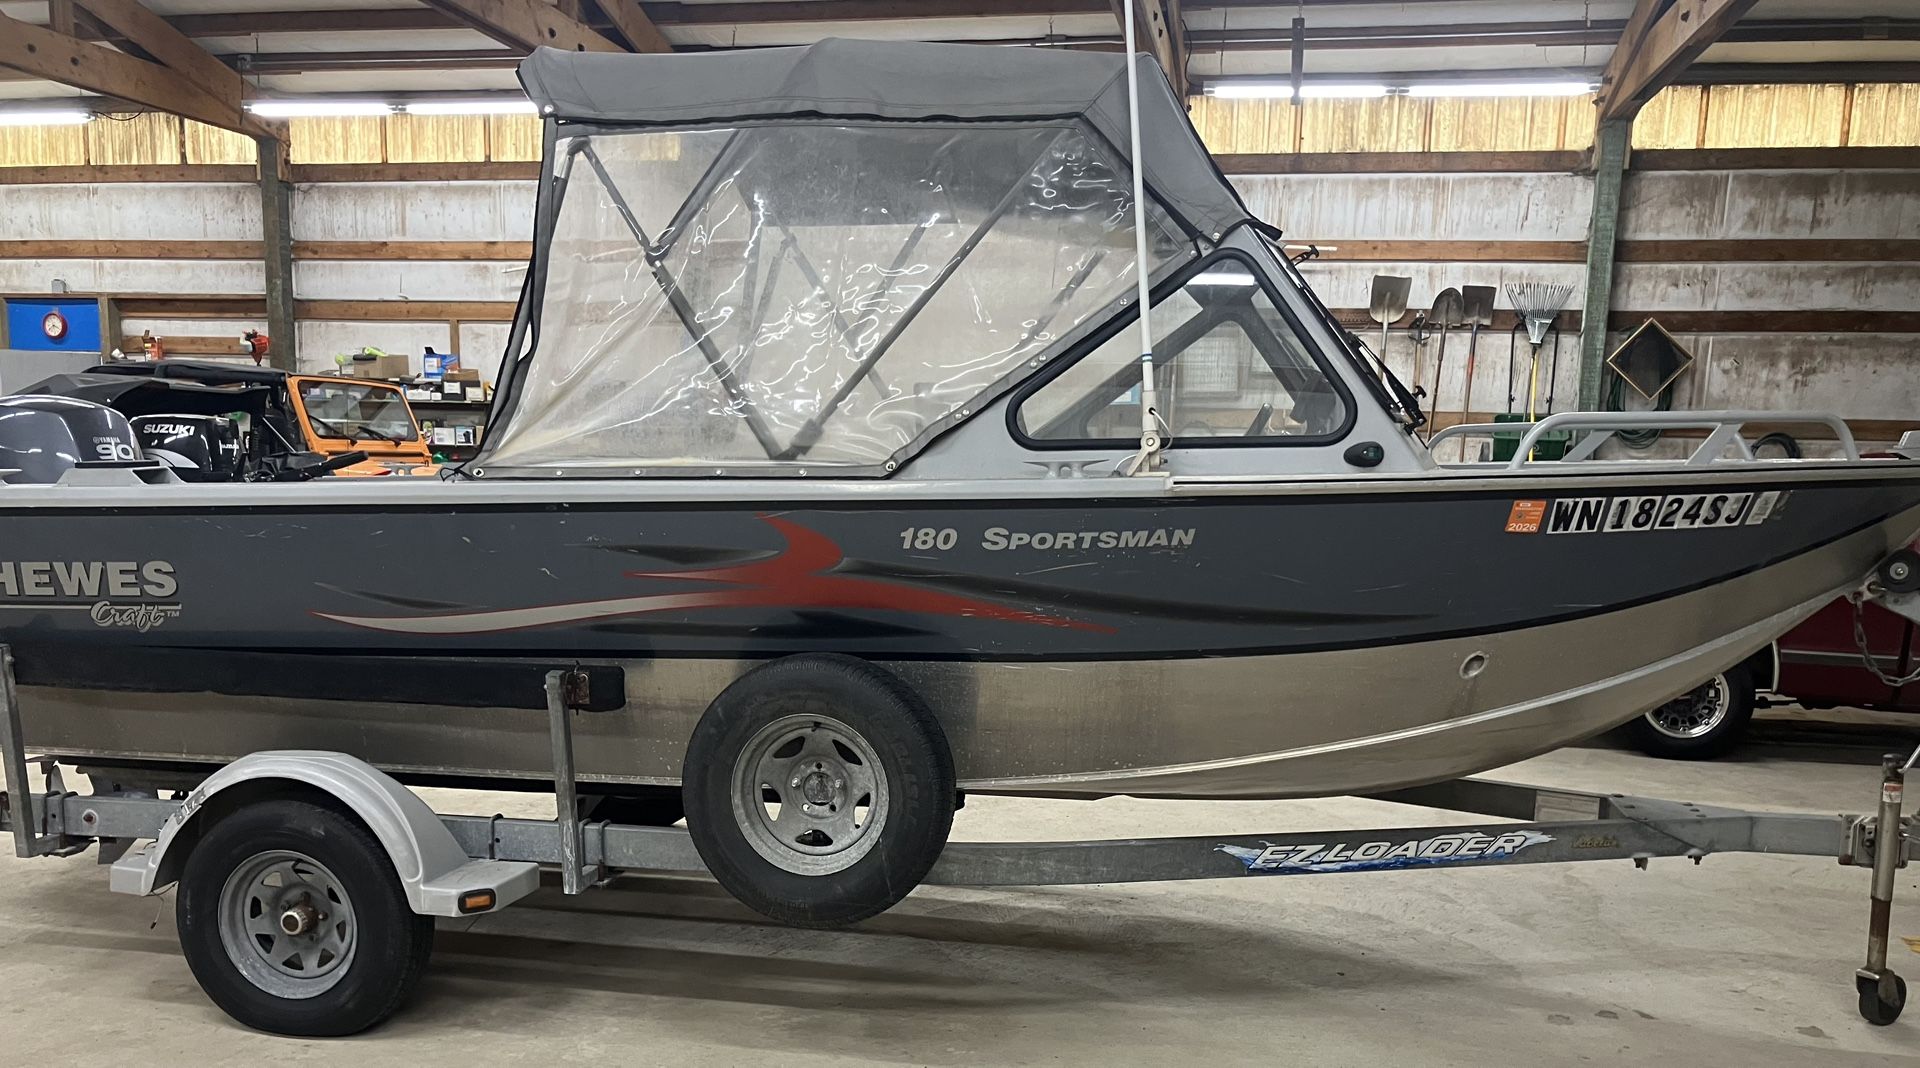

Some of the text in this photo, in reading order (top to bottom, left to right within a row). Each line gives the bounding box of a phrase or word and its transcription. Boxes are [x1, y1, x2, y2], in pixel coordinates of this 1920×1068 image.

[143, 424, 195, 436] SUZUKI
[96, 444, 134, 460] 90
[1551, 499, 1604, 532] WN
[1508, 523, 1537, 531] 2026
[900, 527, 1197, 550] 180 SPORTSMAN
[90, 600, 166, 633] Craft
